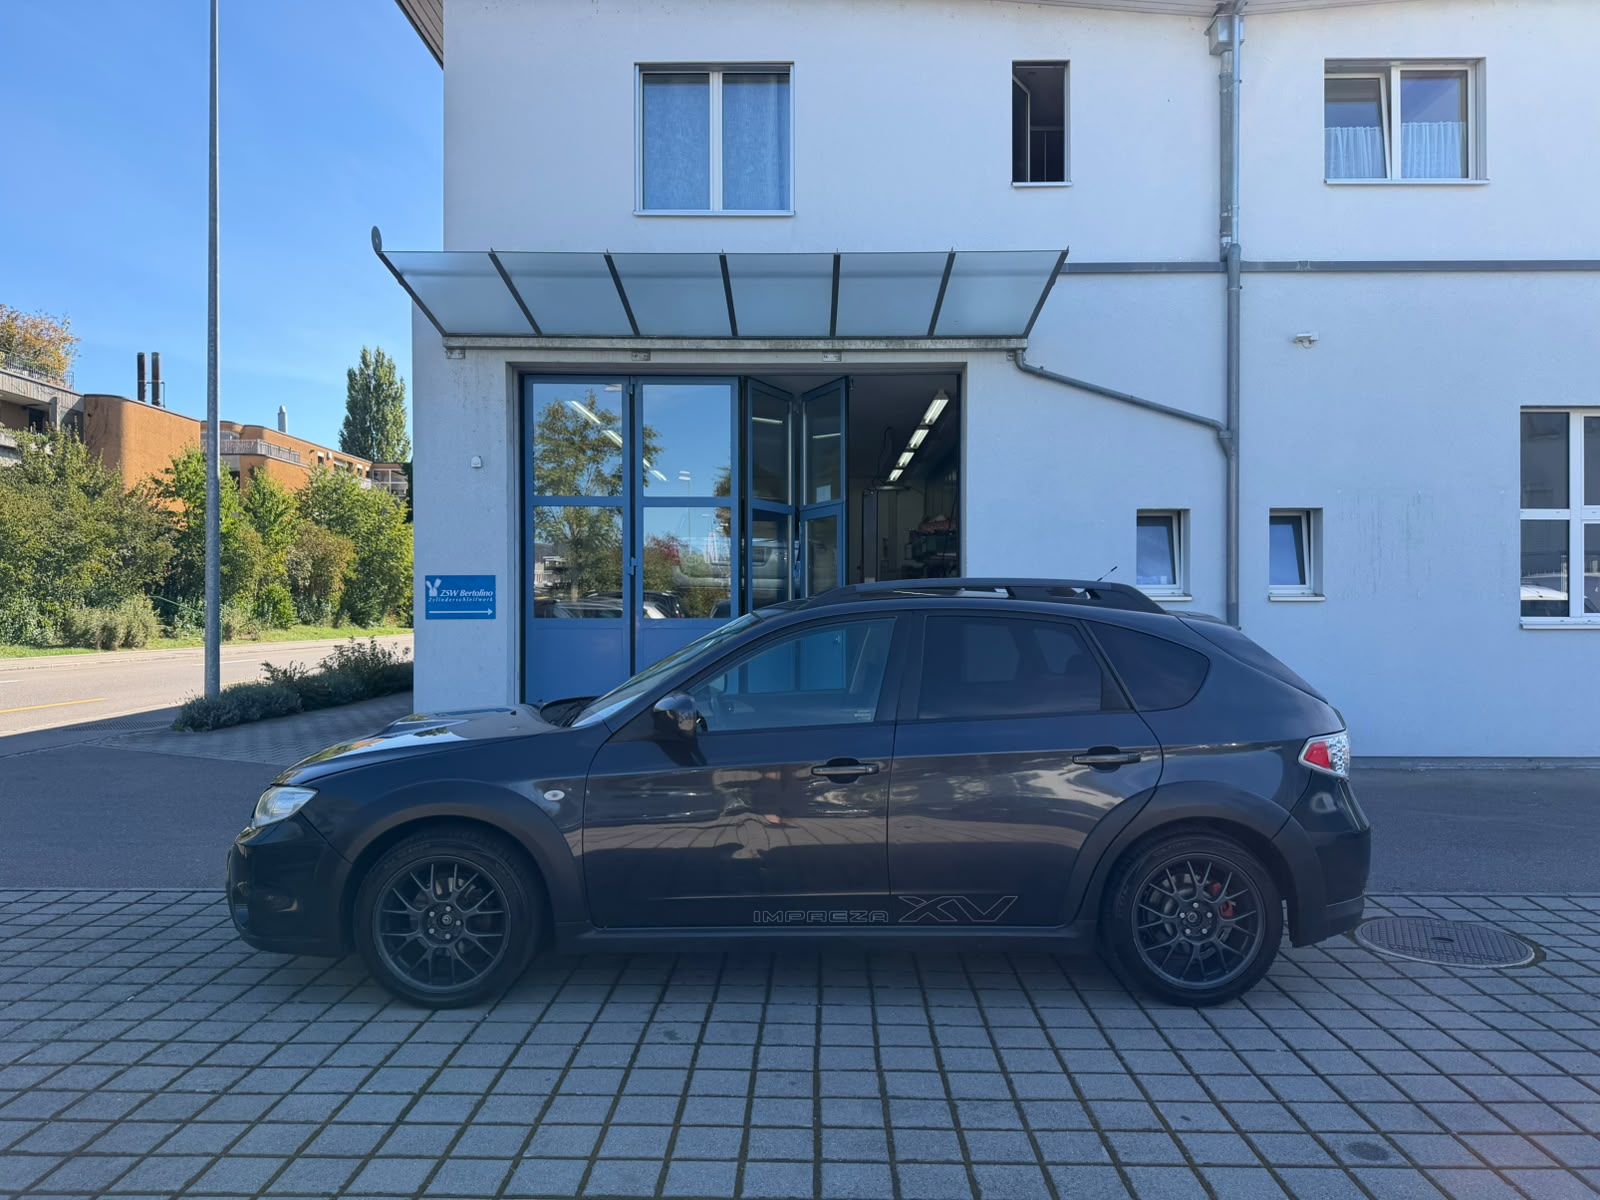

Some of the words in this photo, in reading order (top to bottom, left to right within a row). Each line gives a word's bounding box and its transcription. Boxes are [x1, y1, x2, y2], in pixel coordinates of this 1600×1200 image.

[440, 589, 459, 597] ZSW
[459, 588, 494, 597] Bertolino
[753, 910, 889, 923] IMPREZA
[898, 895, 1019, 923] XV
